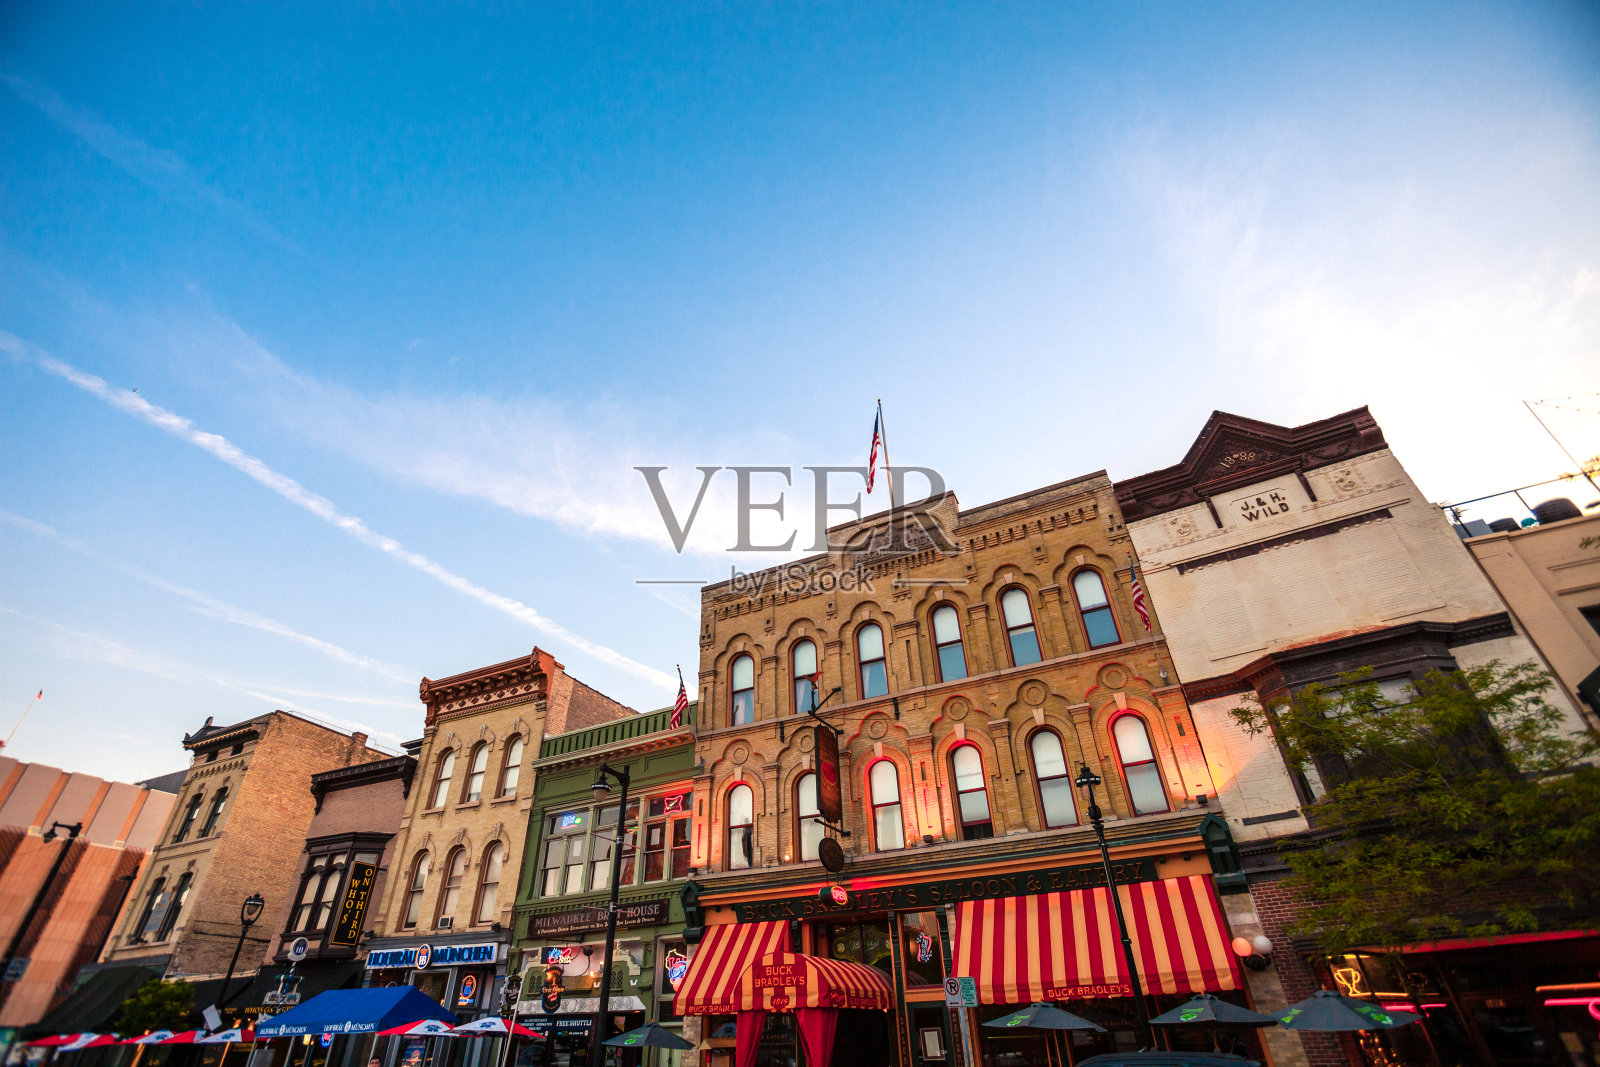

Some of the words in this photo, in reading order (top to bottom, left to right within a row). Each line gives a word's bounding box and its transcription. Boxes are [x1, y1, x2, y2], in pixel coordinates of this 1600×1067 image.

[1255, 496, 1268, 508] &
[1241, 502, 1290, 522] WILD
[743, 902, 796, 921] BUCK
[929, 876, 1018, 902] SALOON
[1026, 874, 1043, 892] &
[535, 911, 593, 928] MILWAUKEE
[597, 908, 622, 921] BRT
[626, 904, 660, 918] HOUSE
[765, 964, 793, 976] BUCK
[754, 975, 806, 988] BRADLEY'S
[1048, 987, 1074, 998] BUCK
[1077, 984, 1130, 996] BRADLEY'S
[688, 1005, 708, 1013] BUCK
[709, 1004, 735, 1013] BRADLE
